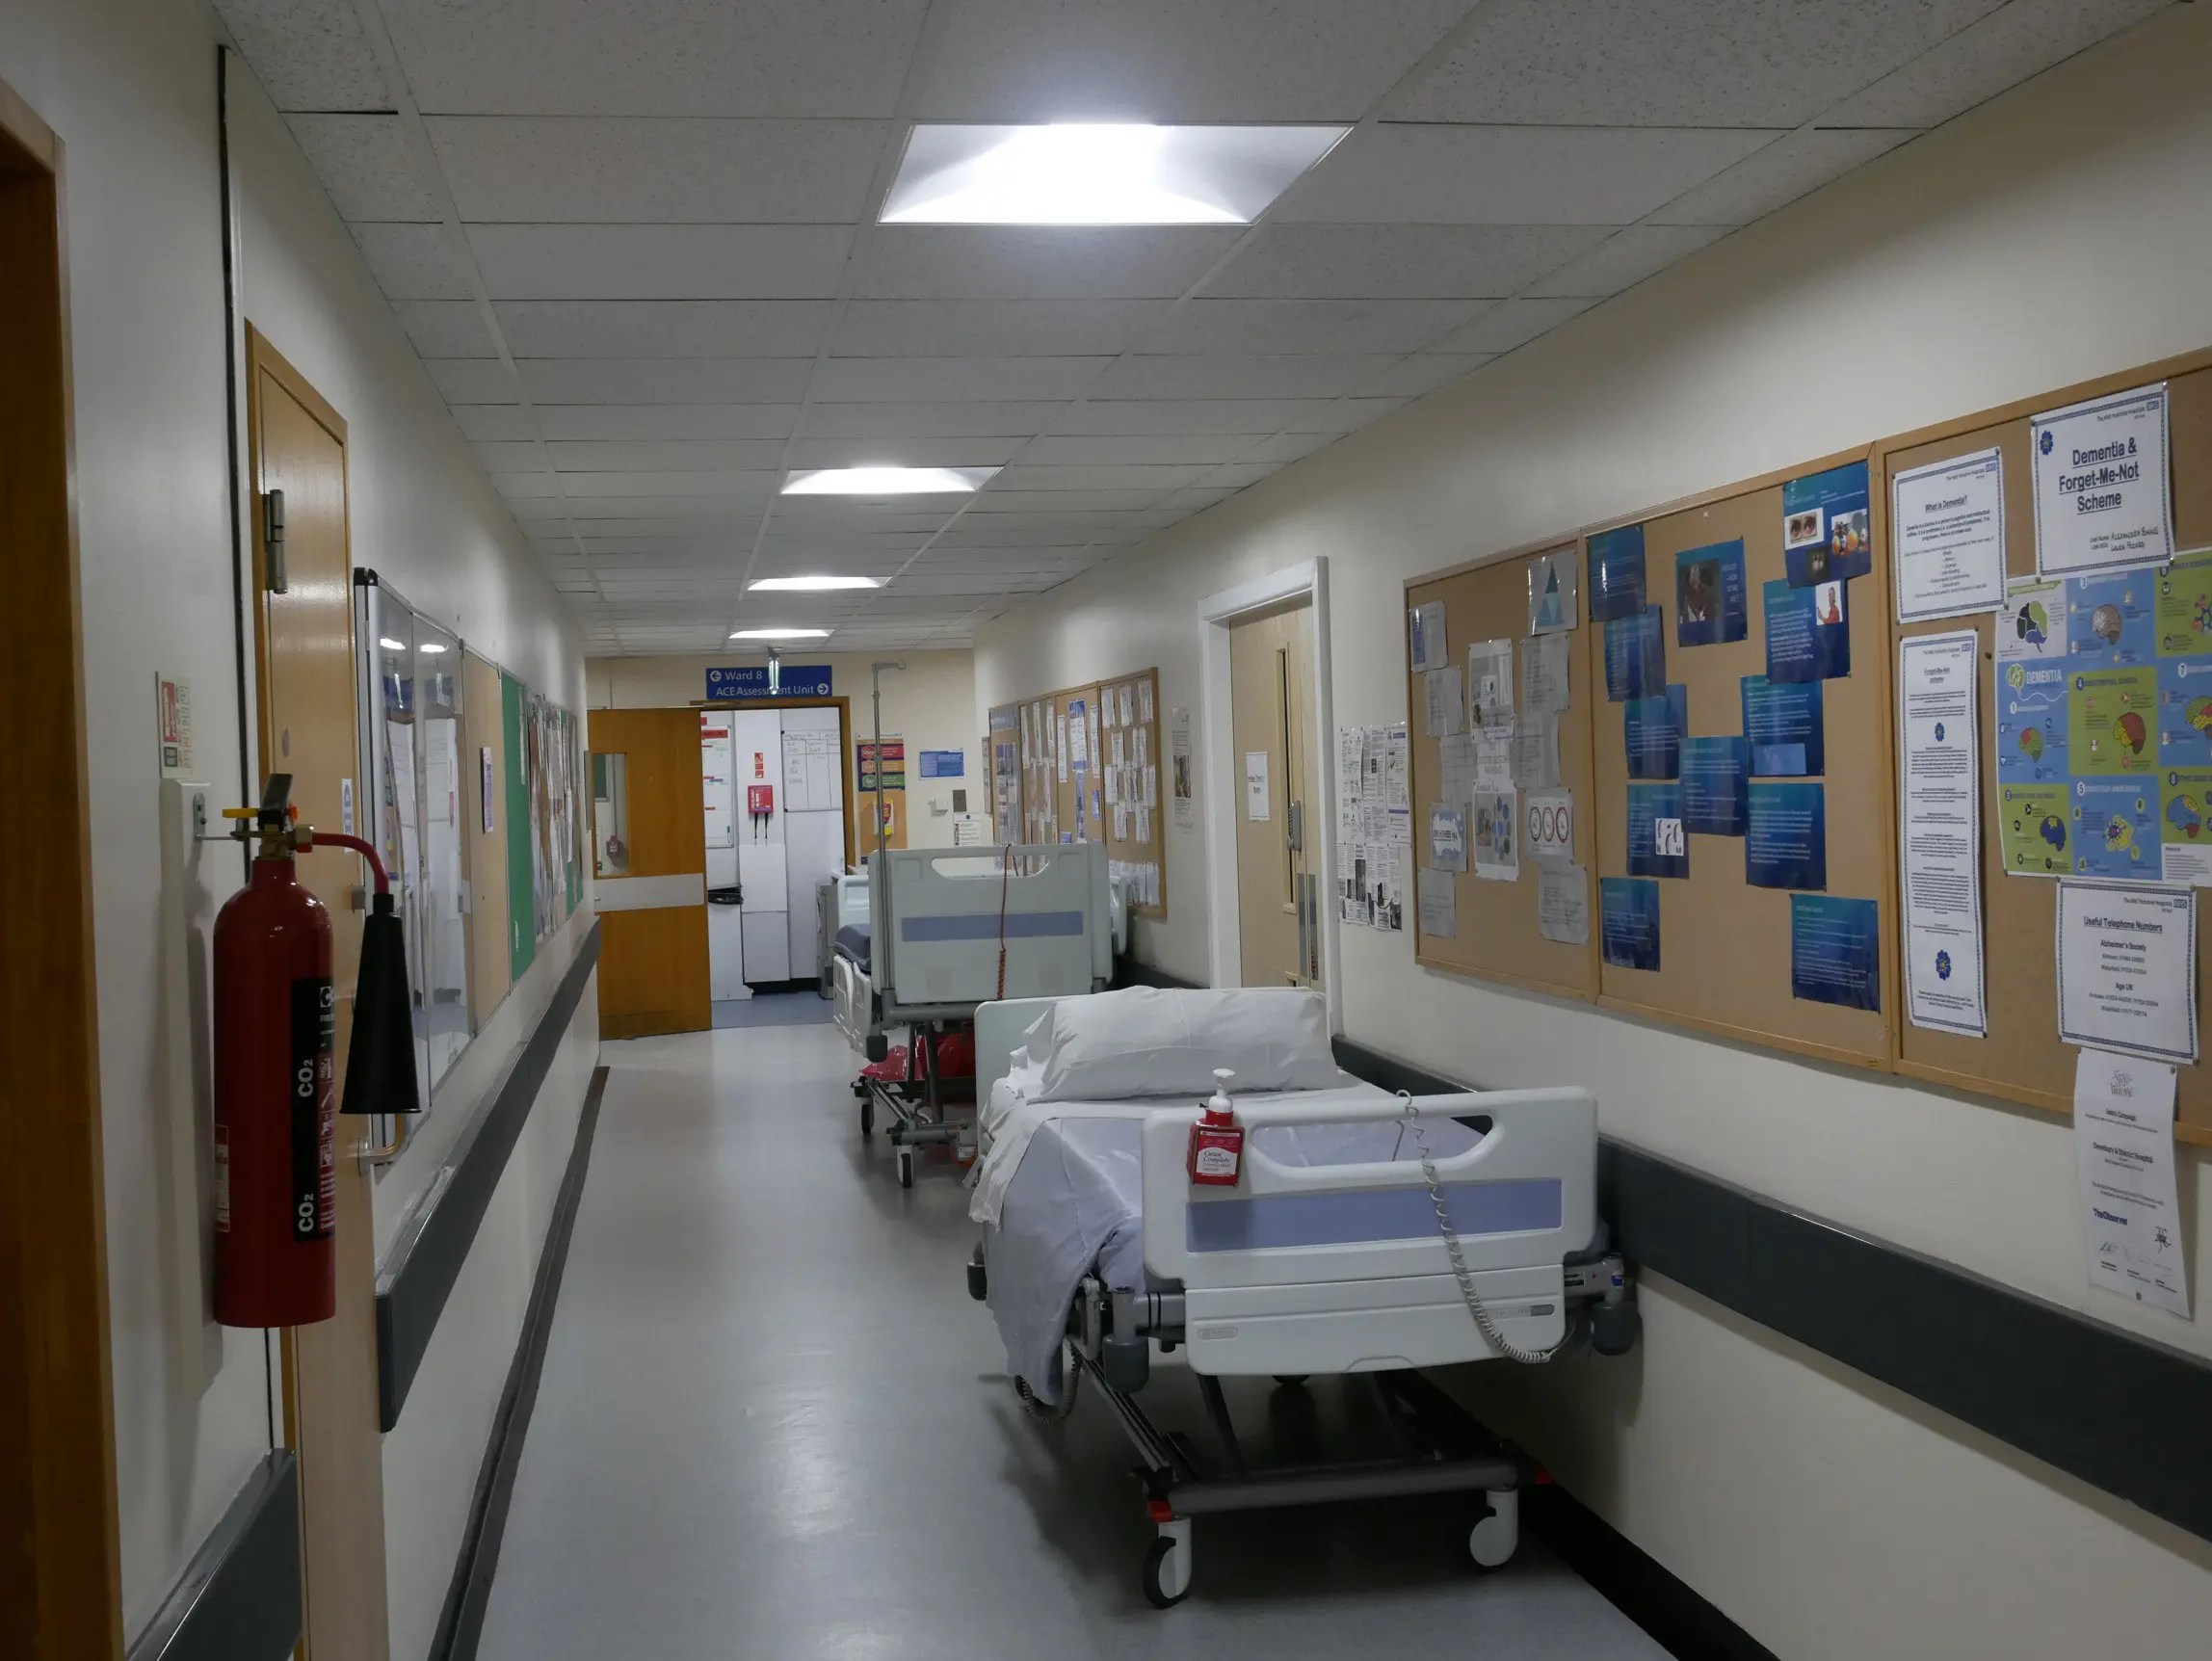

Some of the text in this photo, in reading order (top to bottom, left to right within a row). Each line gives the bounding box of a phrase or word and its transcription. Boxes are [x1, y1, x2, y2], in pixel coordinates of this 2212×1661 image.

[2072, 437, 2137, 465] Dementia &
[2059, 461, 2140, 491] Forget-Me-Not
[2077, 492, 2121, 513] Scheme
[724, 671, 762, 680] Ward 8
[2026, 670, 2062, 684] DEMENTIA
[716, 687, 735, 697] ACE
[794, 685, 814, 695] Unit
[2084, 915, 2162, 933] Useful Telephone Numbers
[2129, 942, 2146, 952] Society
[2116, 982, 2134, 991] Age UK
